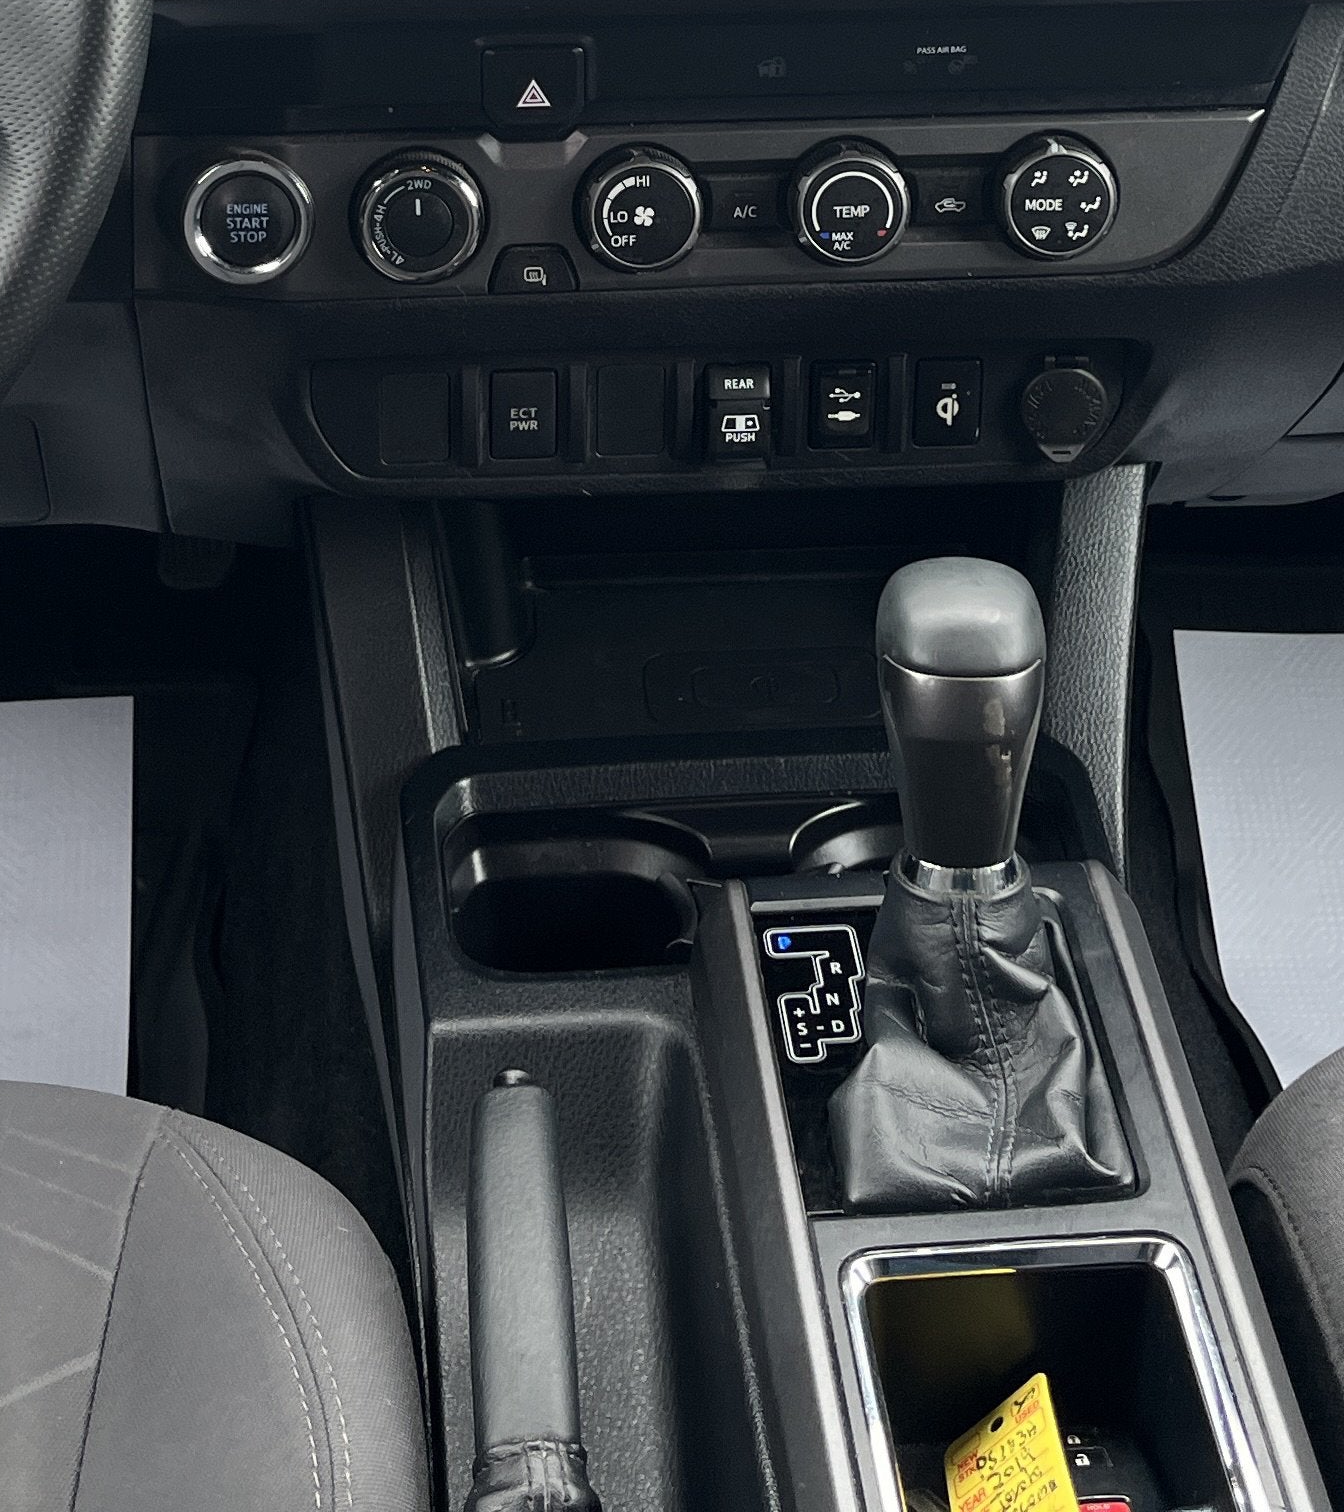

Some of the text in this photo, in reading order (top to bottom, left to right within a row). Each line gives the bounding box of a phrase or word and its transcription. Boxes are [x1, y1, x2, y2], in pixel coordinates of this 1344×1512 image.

[406, 179, 432, 190] 2WD
[635, 175, 650, 187] HI
[226, 203, 268, 214] ENGINE
[833, 205, 870, 218] TEMP
[1025, 199, 1063, 212] MODE
[610, 210, 628, 223] LO
[733, 205, 757, 219] A/C
[226, 217, 269, 229] START
[230, 231, 267, 243] STOP
[611, 235, 637, 247] OFF
[831, 232, 854, 241] MAX
[833, 241, 851, 251] A/C
[724, 379, 754, 390] REAR
[510, 408, 538, 419] ECT
[510, 420, 538, 431] PWR
[725, 432, 756, 443] PUSH
[830, 962, 842, 974] R
[825, 993, 840, 1006] N
[796, 1022, 808, 1036] S
[831, 1020, 845, 1033] D
[1015, 1400, 1040, 1424] USED
[957, 1449, 978, 1472] NEW
[959, 1488, 986, 1512] YEAR
